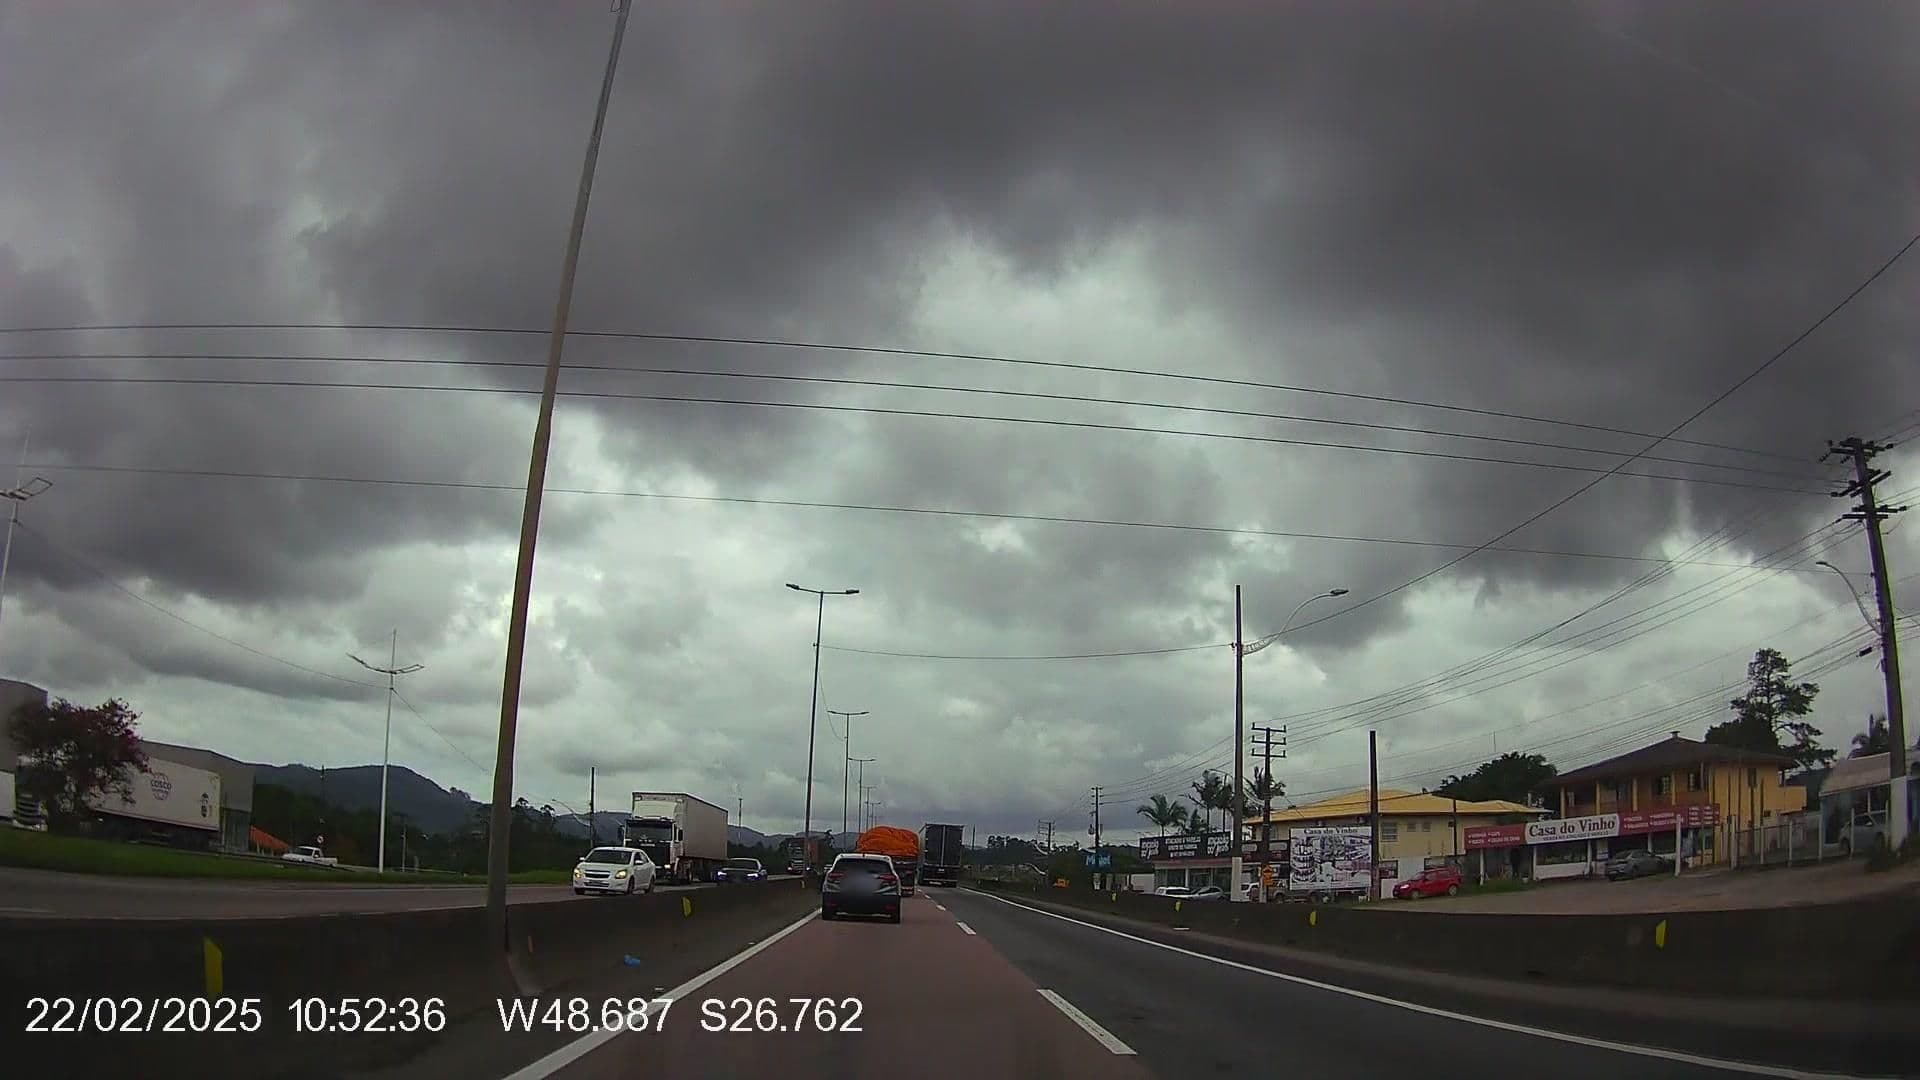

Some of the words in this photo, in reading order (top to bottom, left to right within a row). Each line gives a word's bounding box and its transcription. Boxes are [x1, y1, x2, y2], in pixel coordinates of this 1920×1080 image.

[1529, 824, 1556, 837] Casa
[1560, 821, 1575, 834] do
[1579, 817, 1615, 832] Vinho
